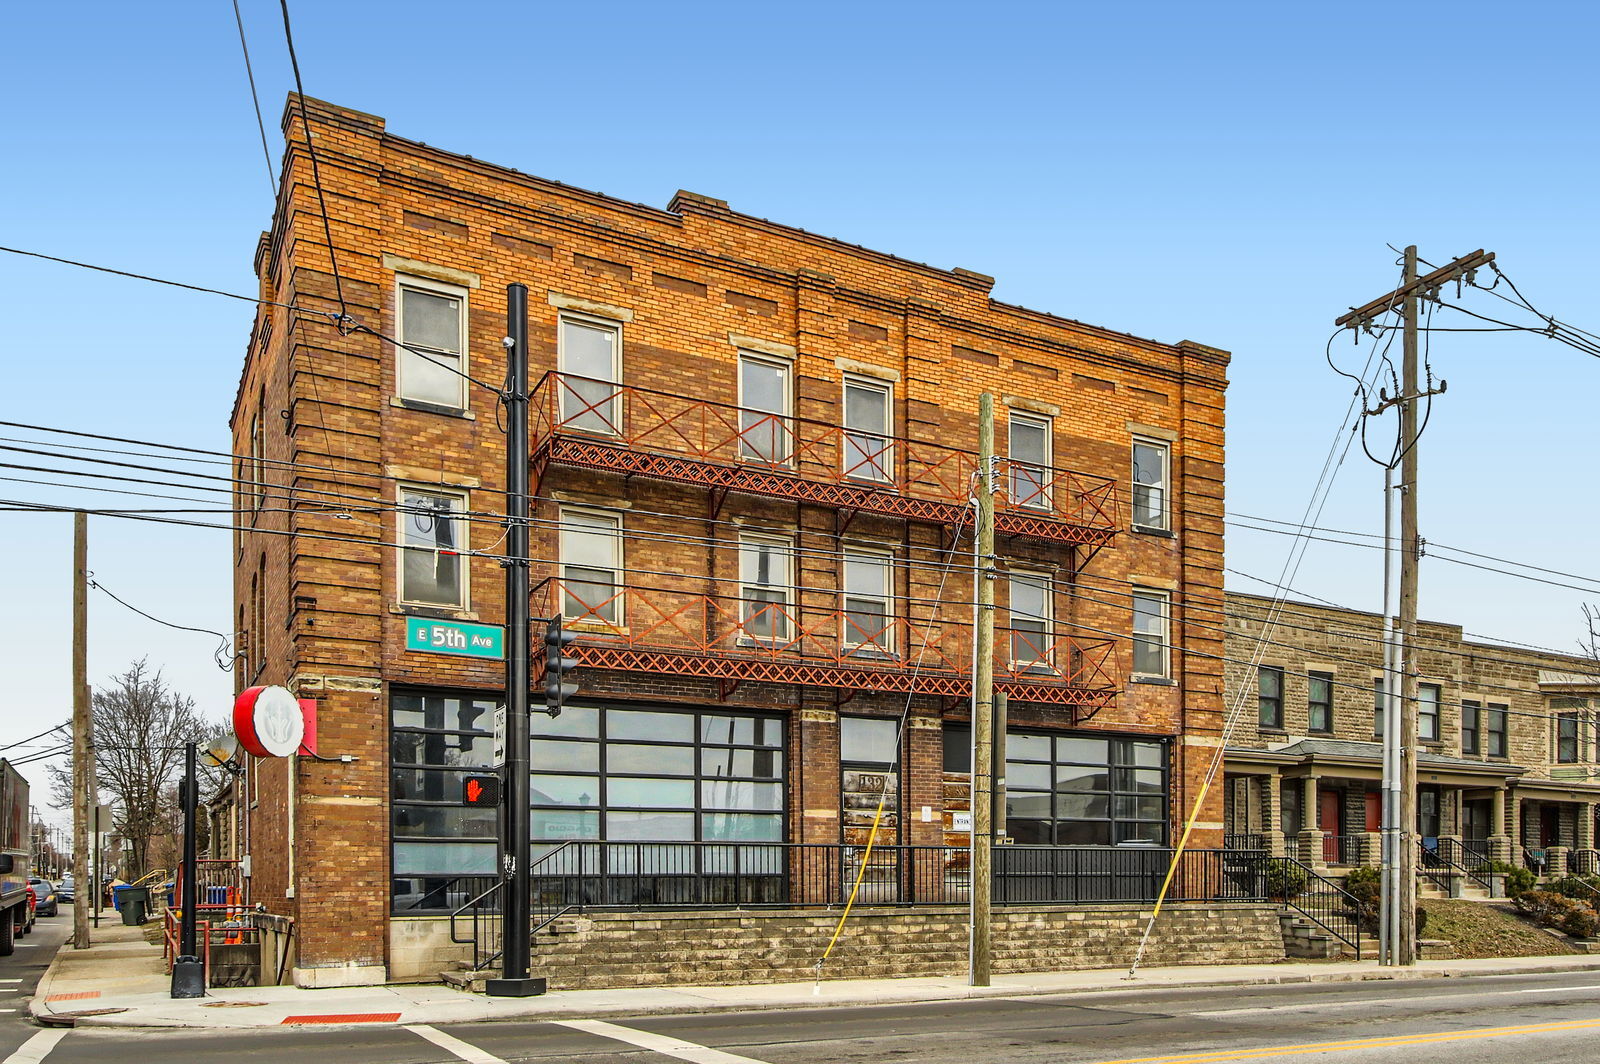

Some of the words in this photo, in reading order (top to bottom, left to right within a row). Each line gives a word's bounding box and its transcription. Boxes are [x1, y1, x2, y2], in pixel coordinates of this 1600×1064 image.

[418, 630, 426, 640] E
[433, 627, 466, 648] 5th
[472, 636, 492, 646] Ave
[495, 711, 504, 727] ONE
[495, 728, 504, 742] WAY
